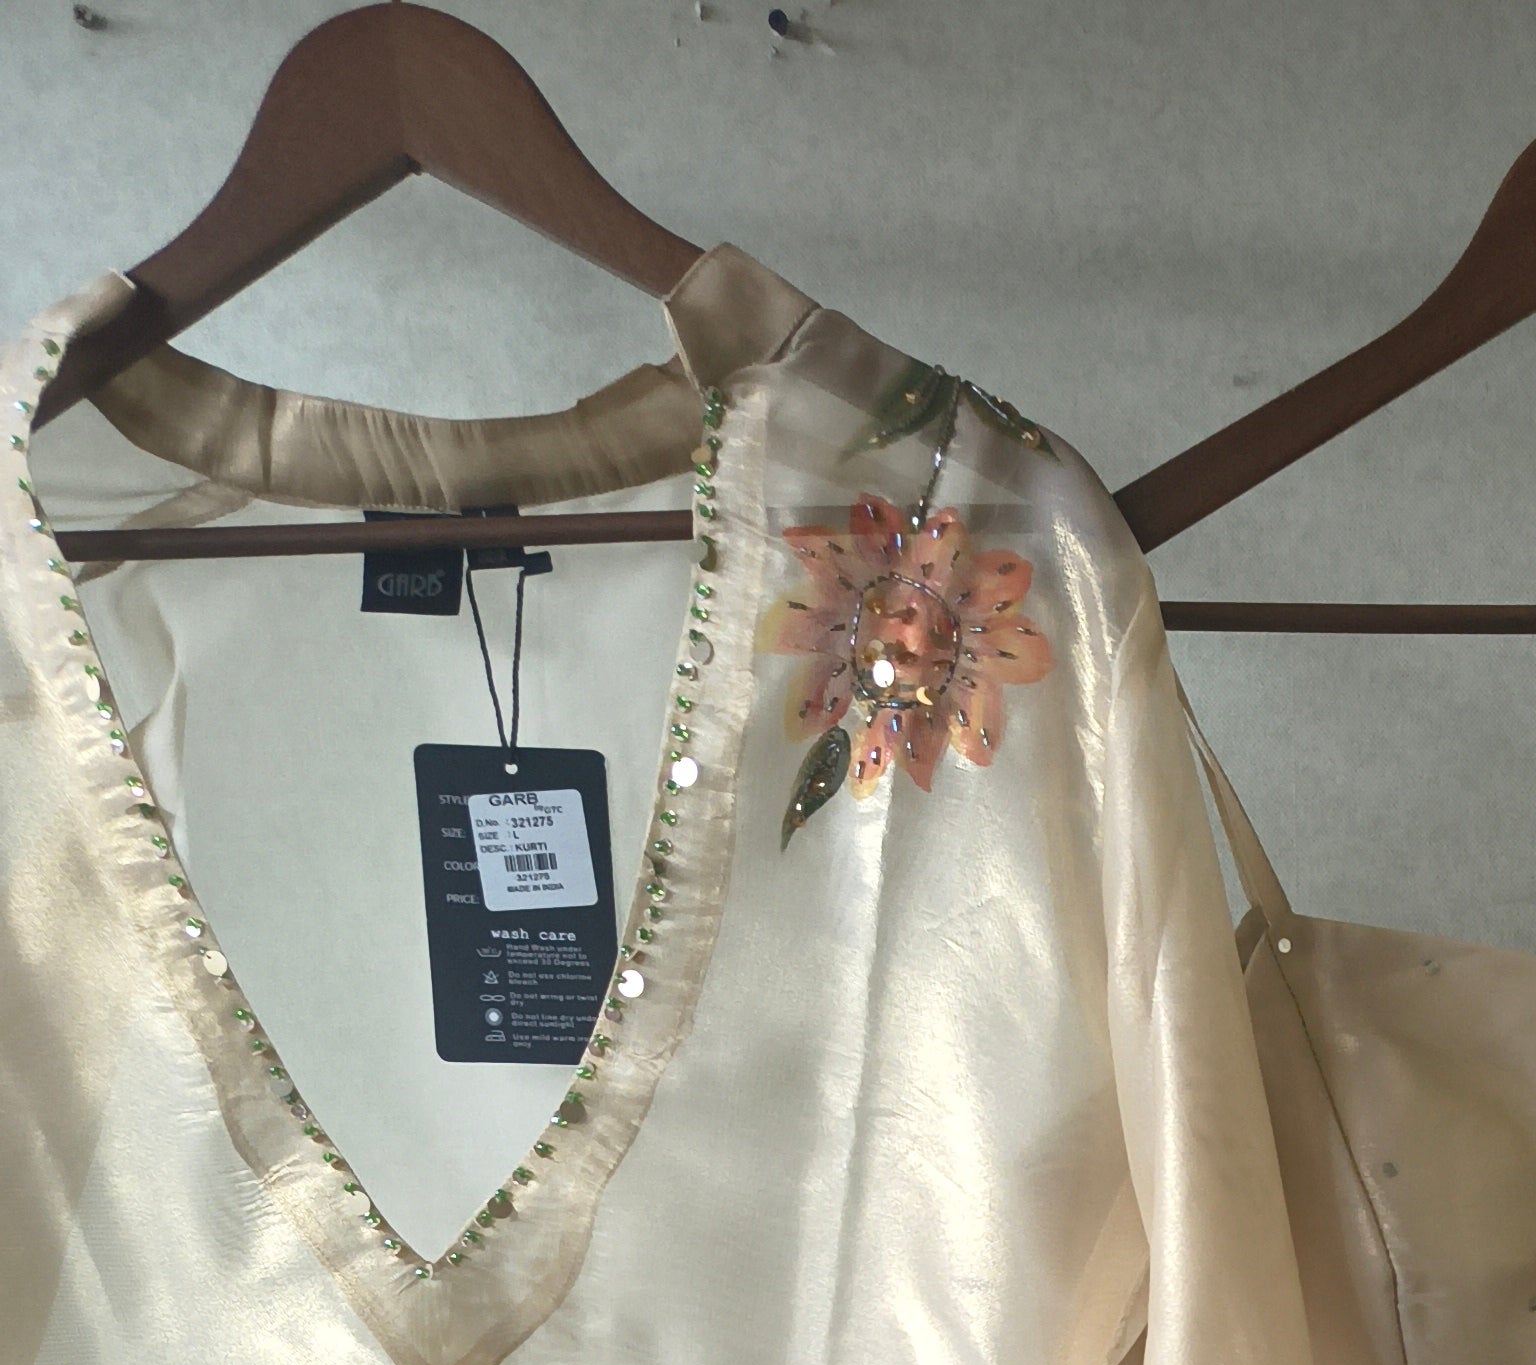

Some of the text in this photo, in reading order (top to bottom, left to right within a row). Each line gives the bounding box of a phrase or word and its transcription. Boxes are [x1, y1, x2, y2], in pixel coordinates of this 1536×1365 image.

[489, 792, 539, 807] GARB
[511, 816, 554, 828] 321275
[478, 832, 499, 840] SIZE
[513, 831, 520, 839] L
[515, 842, 547, 851] KURTI
[516, 872, 550, 882] 321275
[507, 885, 530, 893] MADE
[543, 883, 565, 891] INDIA
[491, 928, 576, 941] wash care
[511, 1012, 523, 1020] Do
